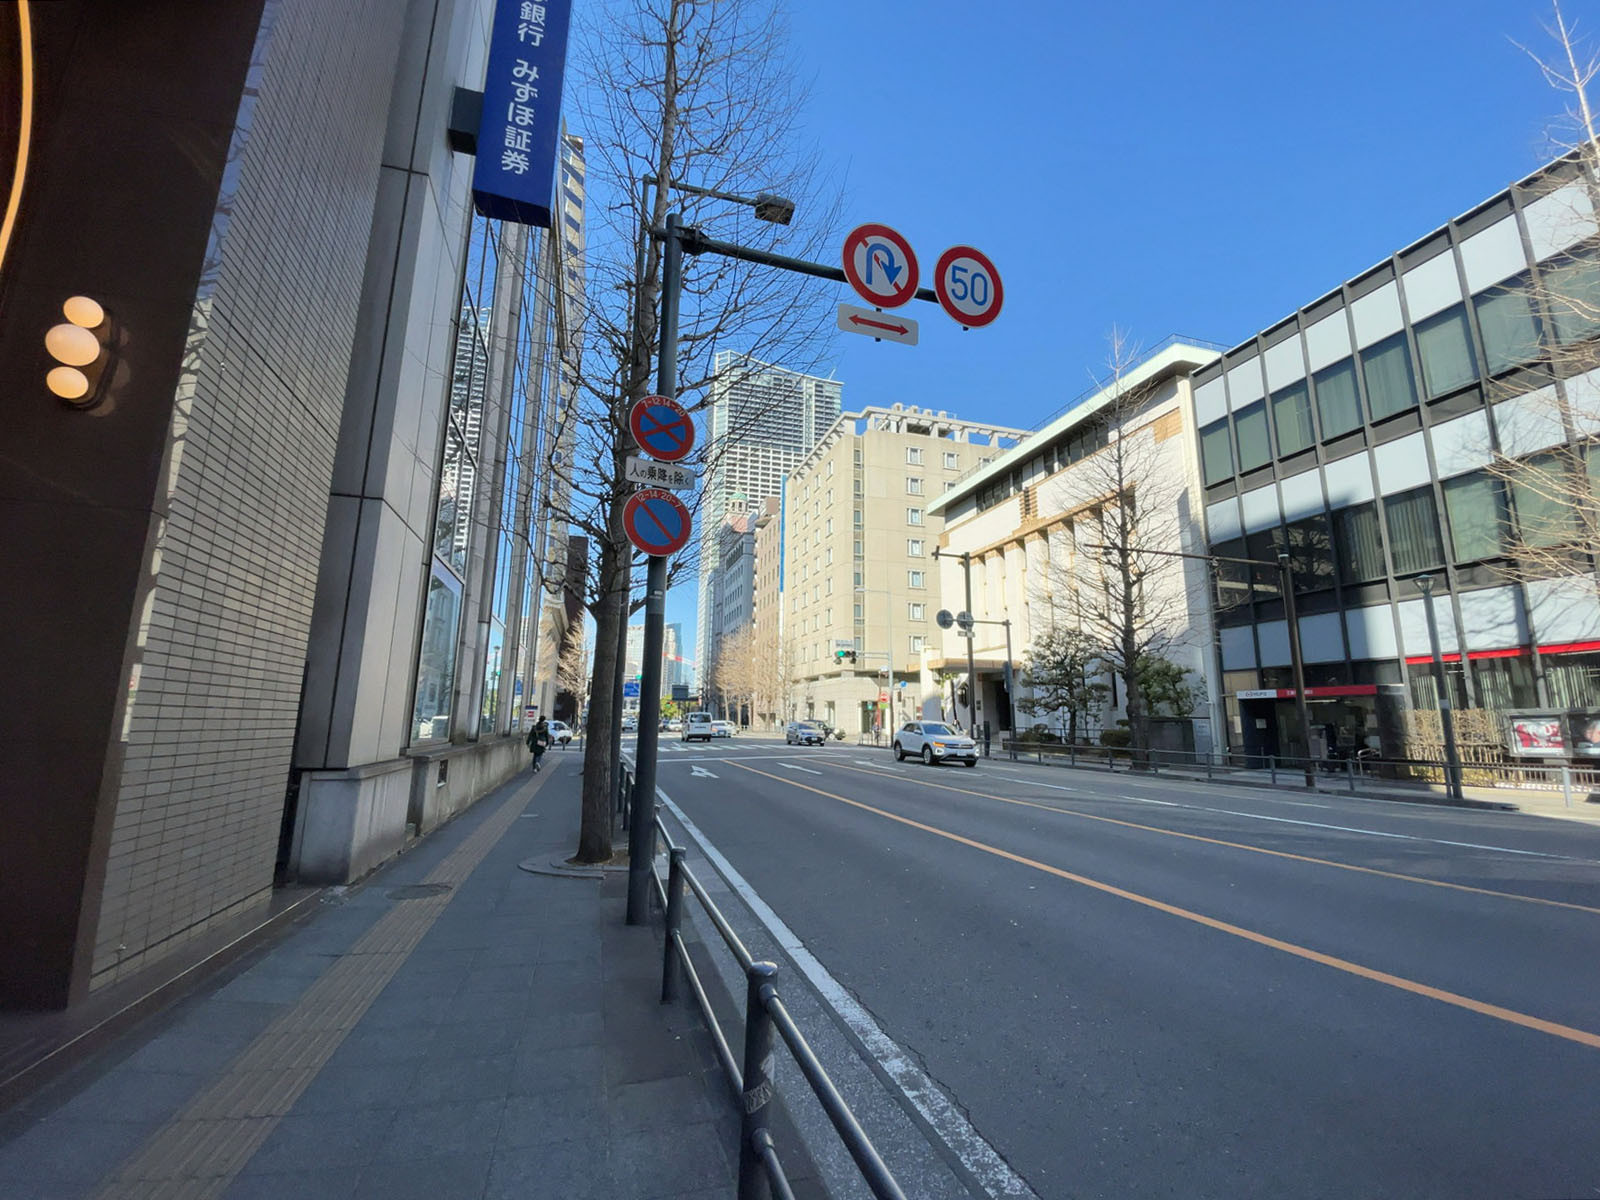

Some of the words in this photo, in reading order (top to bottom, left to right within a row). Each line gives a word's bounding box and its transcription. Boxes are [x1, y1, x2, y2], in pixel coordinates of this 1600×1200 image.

[517, 0, 547, 47] 銀行
[502, 59, 540, 175] みずほ証券
[951, 264, 988, 306] 50
[630, 463, 689, 485] 人の乗降を除く
